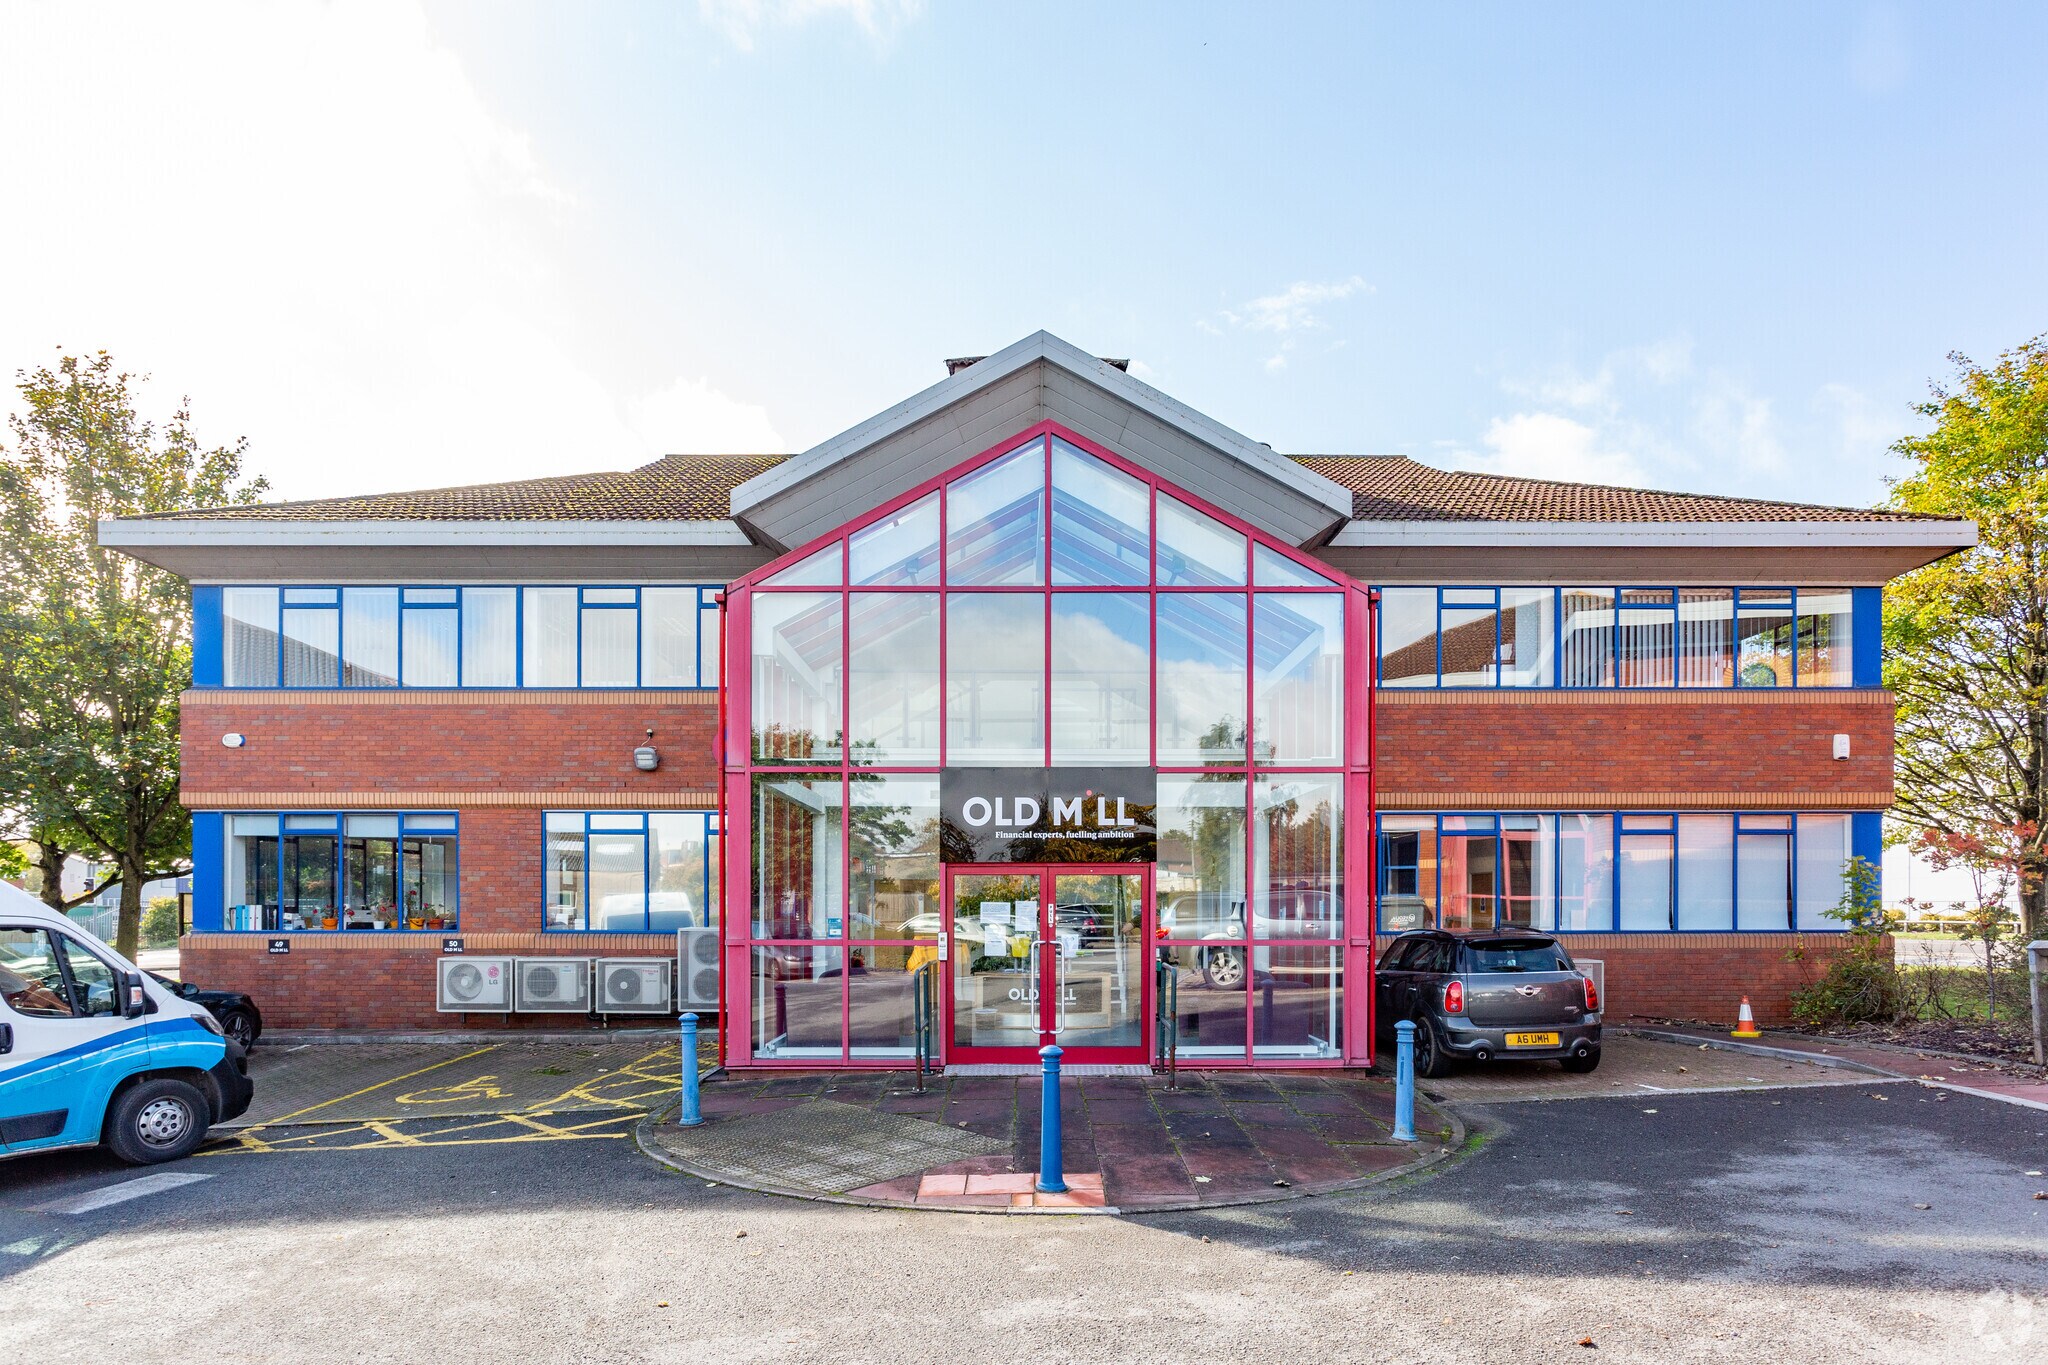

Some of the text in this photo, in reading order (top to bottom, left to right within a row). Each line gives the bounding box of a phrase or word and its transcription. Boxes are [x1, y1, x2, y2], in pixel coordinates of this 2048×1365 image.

[962, 789, 1135, 827] OLD MLL
[995, 830, 1135, 840] Financial experts, fuelling ambition
[1516, 1035, 1549, 1043] A6 UMH
